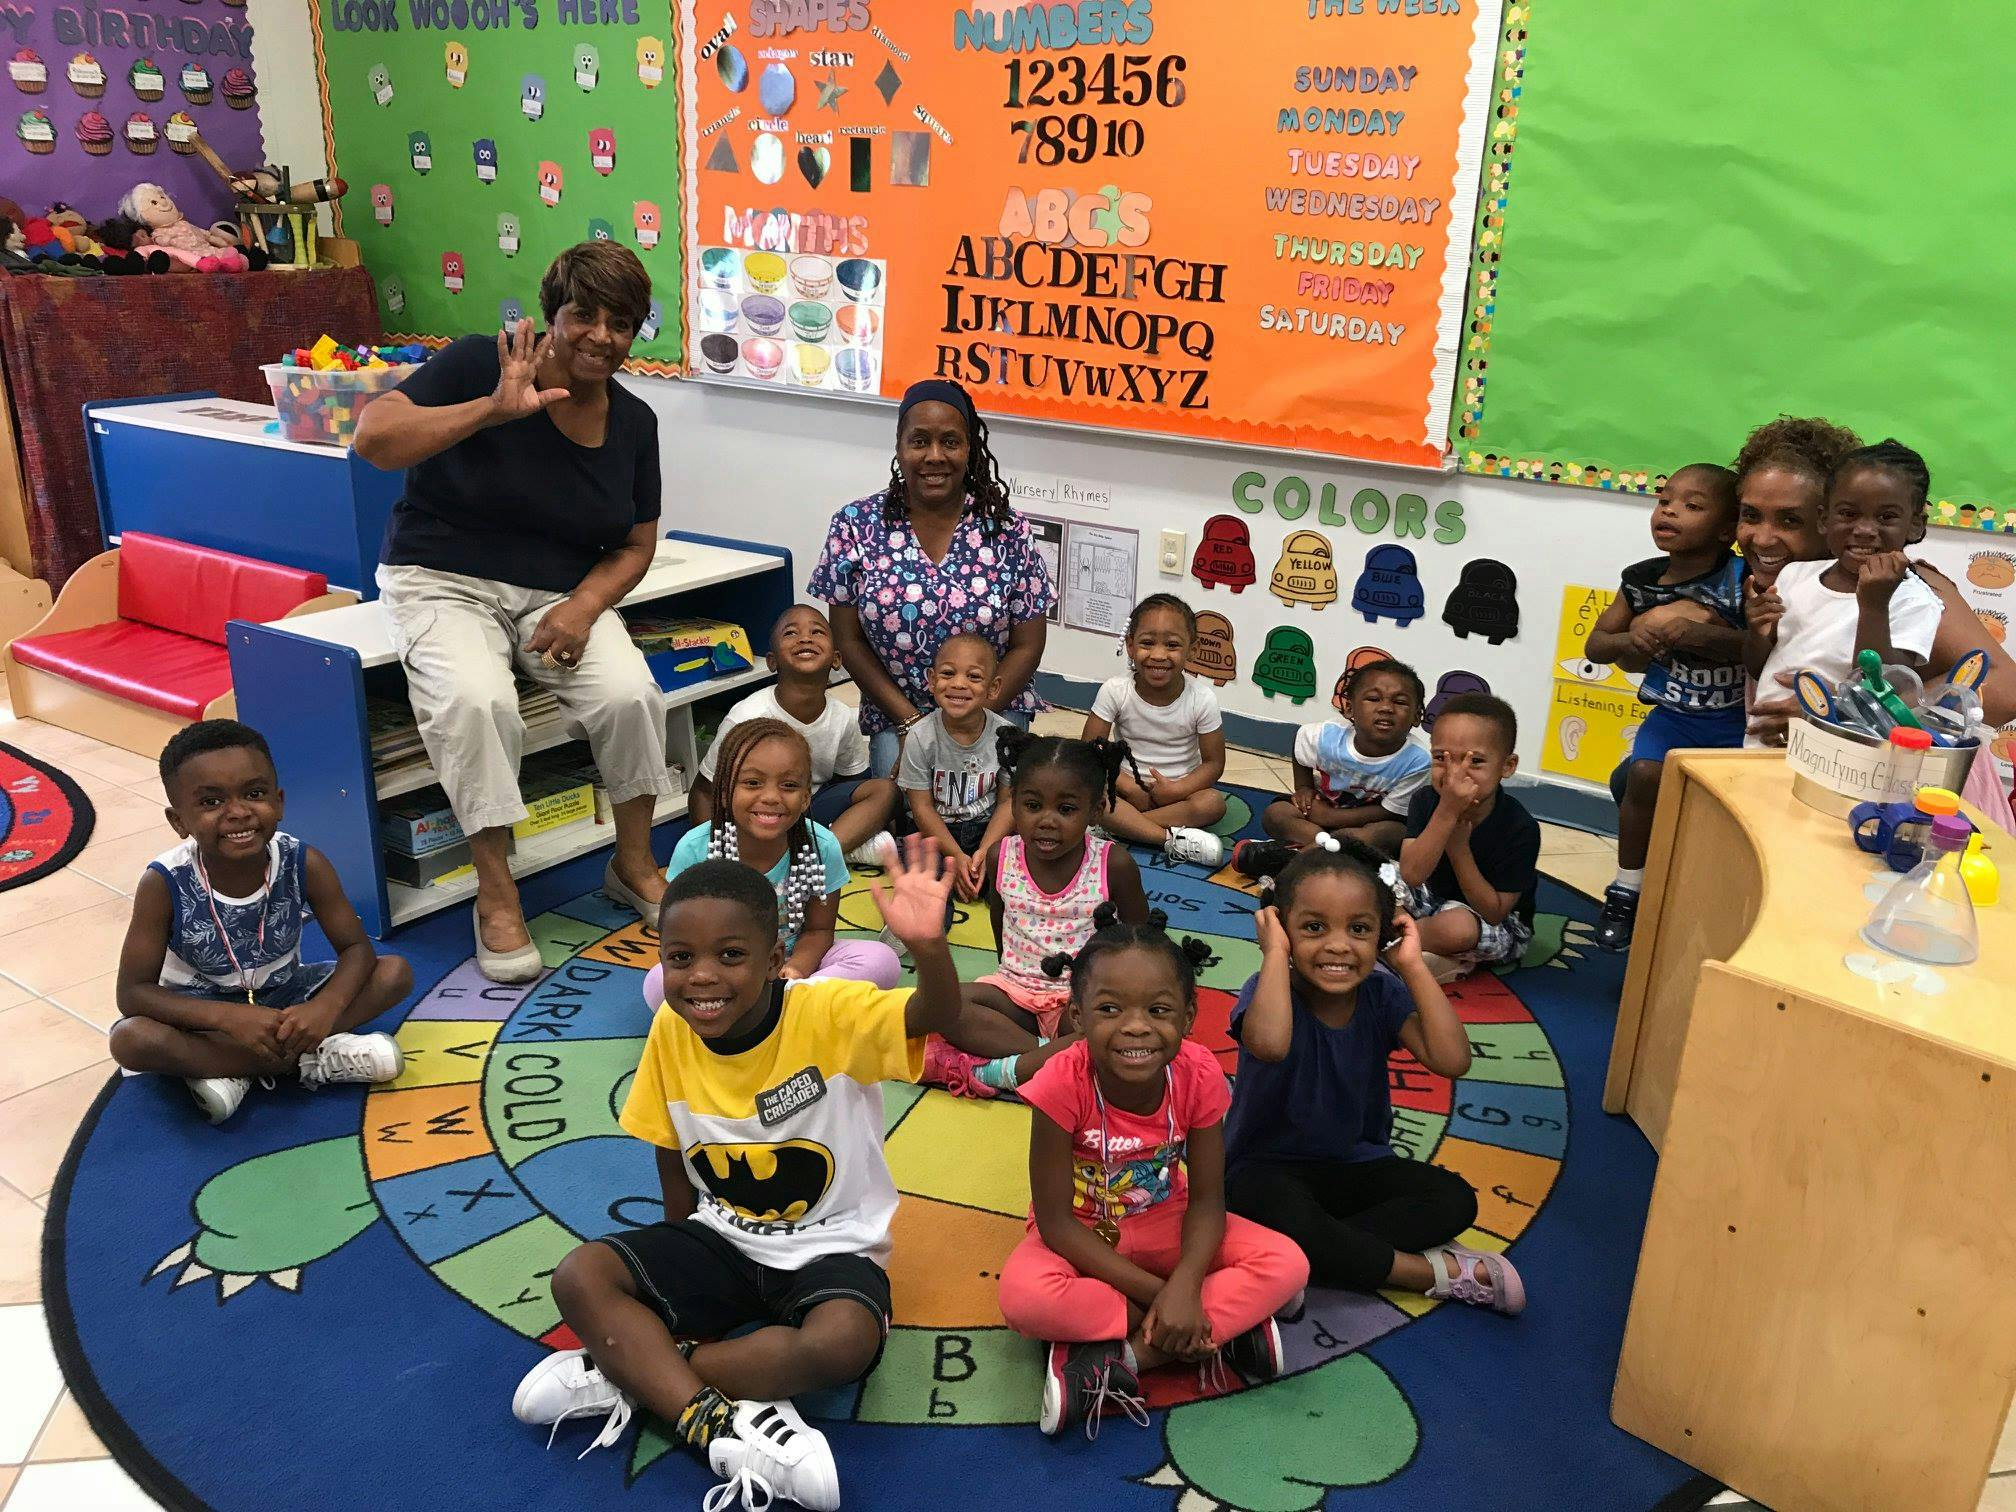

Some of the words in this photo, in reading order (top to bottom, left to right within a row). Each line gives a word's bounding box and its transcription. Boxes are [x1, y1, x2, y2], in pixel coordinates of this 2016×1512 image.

[331, 0, 399, 31] LOOK
[558, 0, 640, 25] HERE
[750, 0, 871, 38] SHAPES
[953, 0, 1154, 53] NUMBERS
[701, 12, 738, 61] oval
[871, 26, 911, 62] diamond
[809, 48, 854, 67] star
[1294, 65, 1418, 94] SUNDAY
[748, 117, 789, 132] circle
[839, 125, 886, 136] rectangle
[1277, 106, 1405, 136] MONDAY
[796, 130, 833, 145] heart
[1288, 148, 1420, 180] TUESDAY
[1265, 187, 1440, 223] WEDNESDAY
[1273, 233, 1424, 270] THURSDAY
[1298, 271, 1394, 305] FRIDAY
[1259, 304, 1406, 346] SATURDAY
[1008, 478, 1055, 500] Nursery
[1064, 484, 1108, 503] Rhymes
[1232, 471, 1466, 545] COLORS
[1213, 543, 1233, 554] RED
[1289, 558, 1331, 571] YELLOW
[1371, 572, 1401, 585] BLUE
[1973, 588, 2002, 598] Frustrated
[1200, 637, 1221, 648] ROWN
[1269, 652, 1304, 665] GREEN
[1557, 685, 1624, 718] Listening
[1788, 729, 1867, 791] Magnifying
[512, 965, 612, 1038] DARK
[503, 1054, 567, 1142] COLD
[764, 1094, 779, 1107] THE
[778, 1073, 812, 1101] CAPED
[764, 1082, 820, 1122] CRUSADER
[1457, 1103, 1511, 1126] G
[1082, 1128, 1143, 1152] Btter
[933, 1335, 977, 1382] B
[928, 1387, 958, 1418] b
